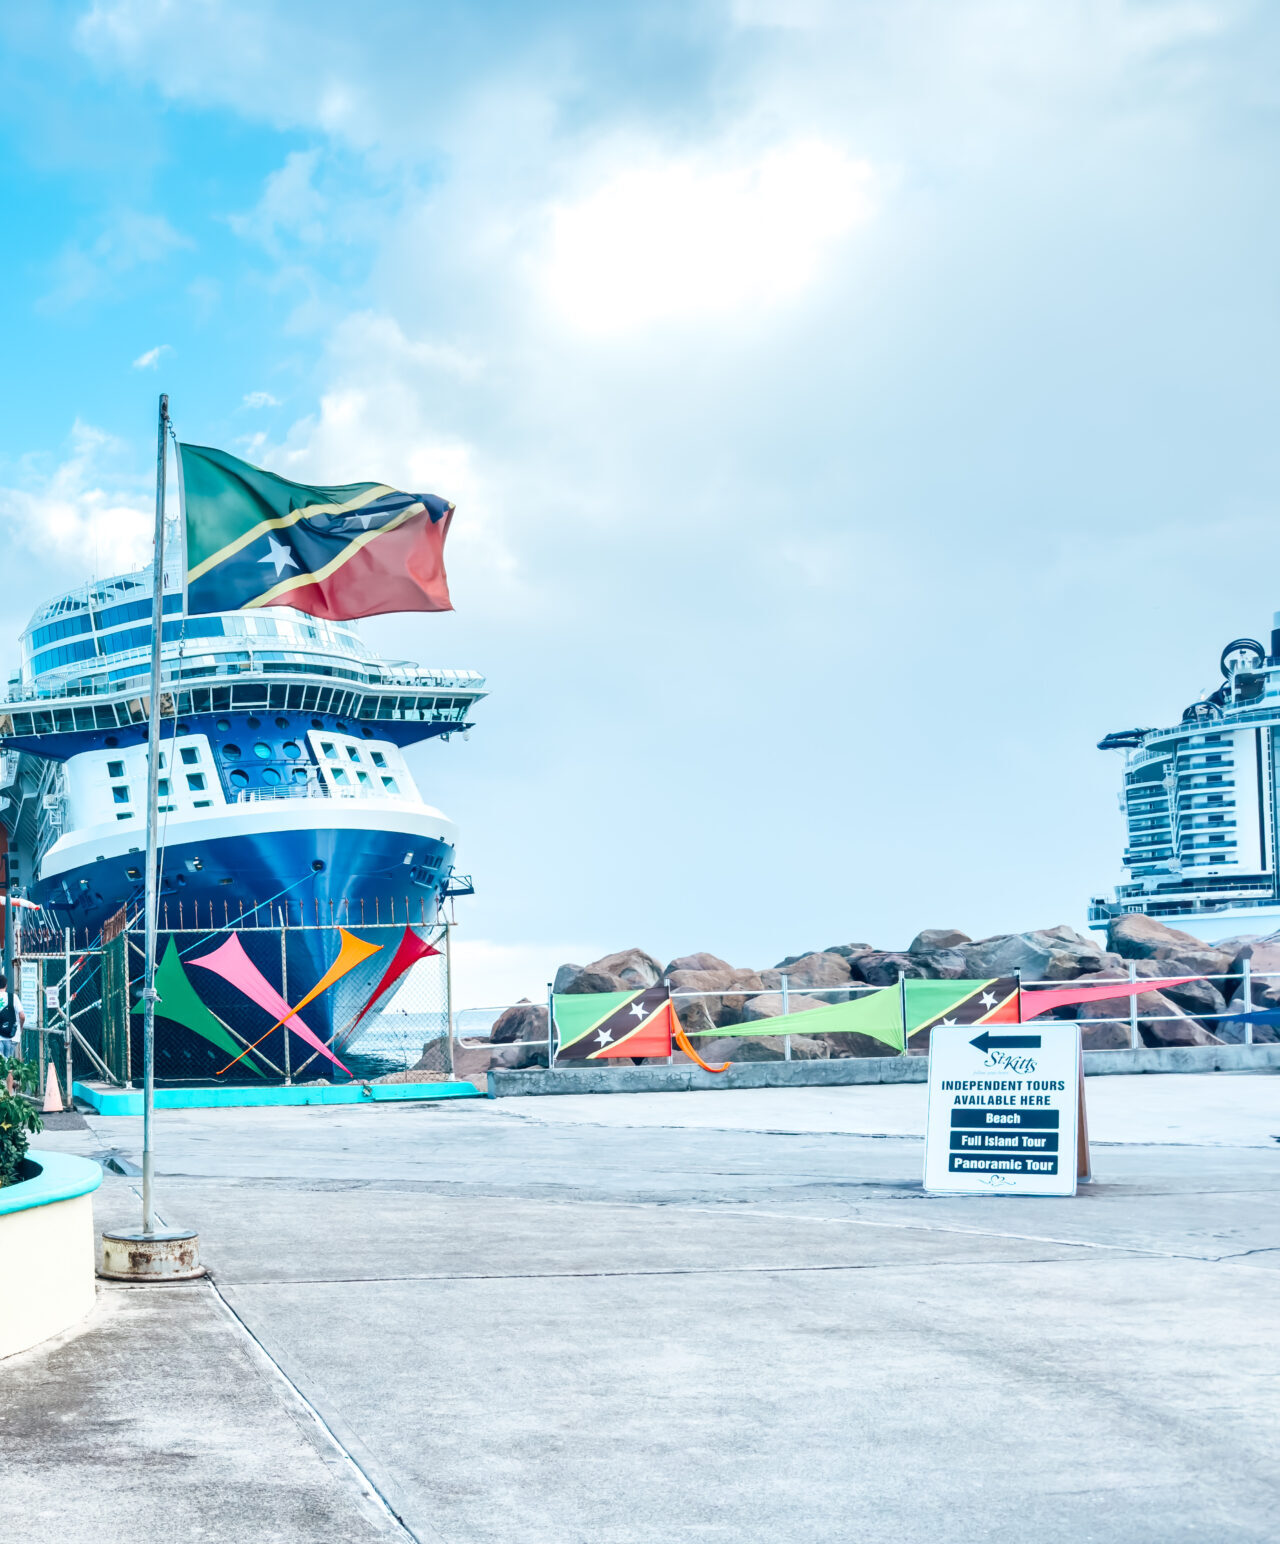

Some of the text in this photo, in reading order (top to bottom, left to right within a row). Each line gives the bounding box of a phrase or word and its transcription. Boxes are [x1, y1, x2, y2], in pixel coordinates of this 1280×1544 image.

[941, 1080, 1065, 1091] INDEPENDENT TOURS
[954, 1095, 1051, 1106] AVAILABLE HERE
[985, 1113, 1021, 1124] Beach
[961, 1135, 1046, 1147] Full Island Tour
[954, 1158, 1054, 1171] Panoramic Tour
